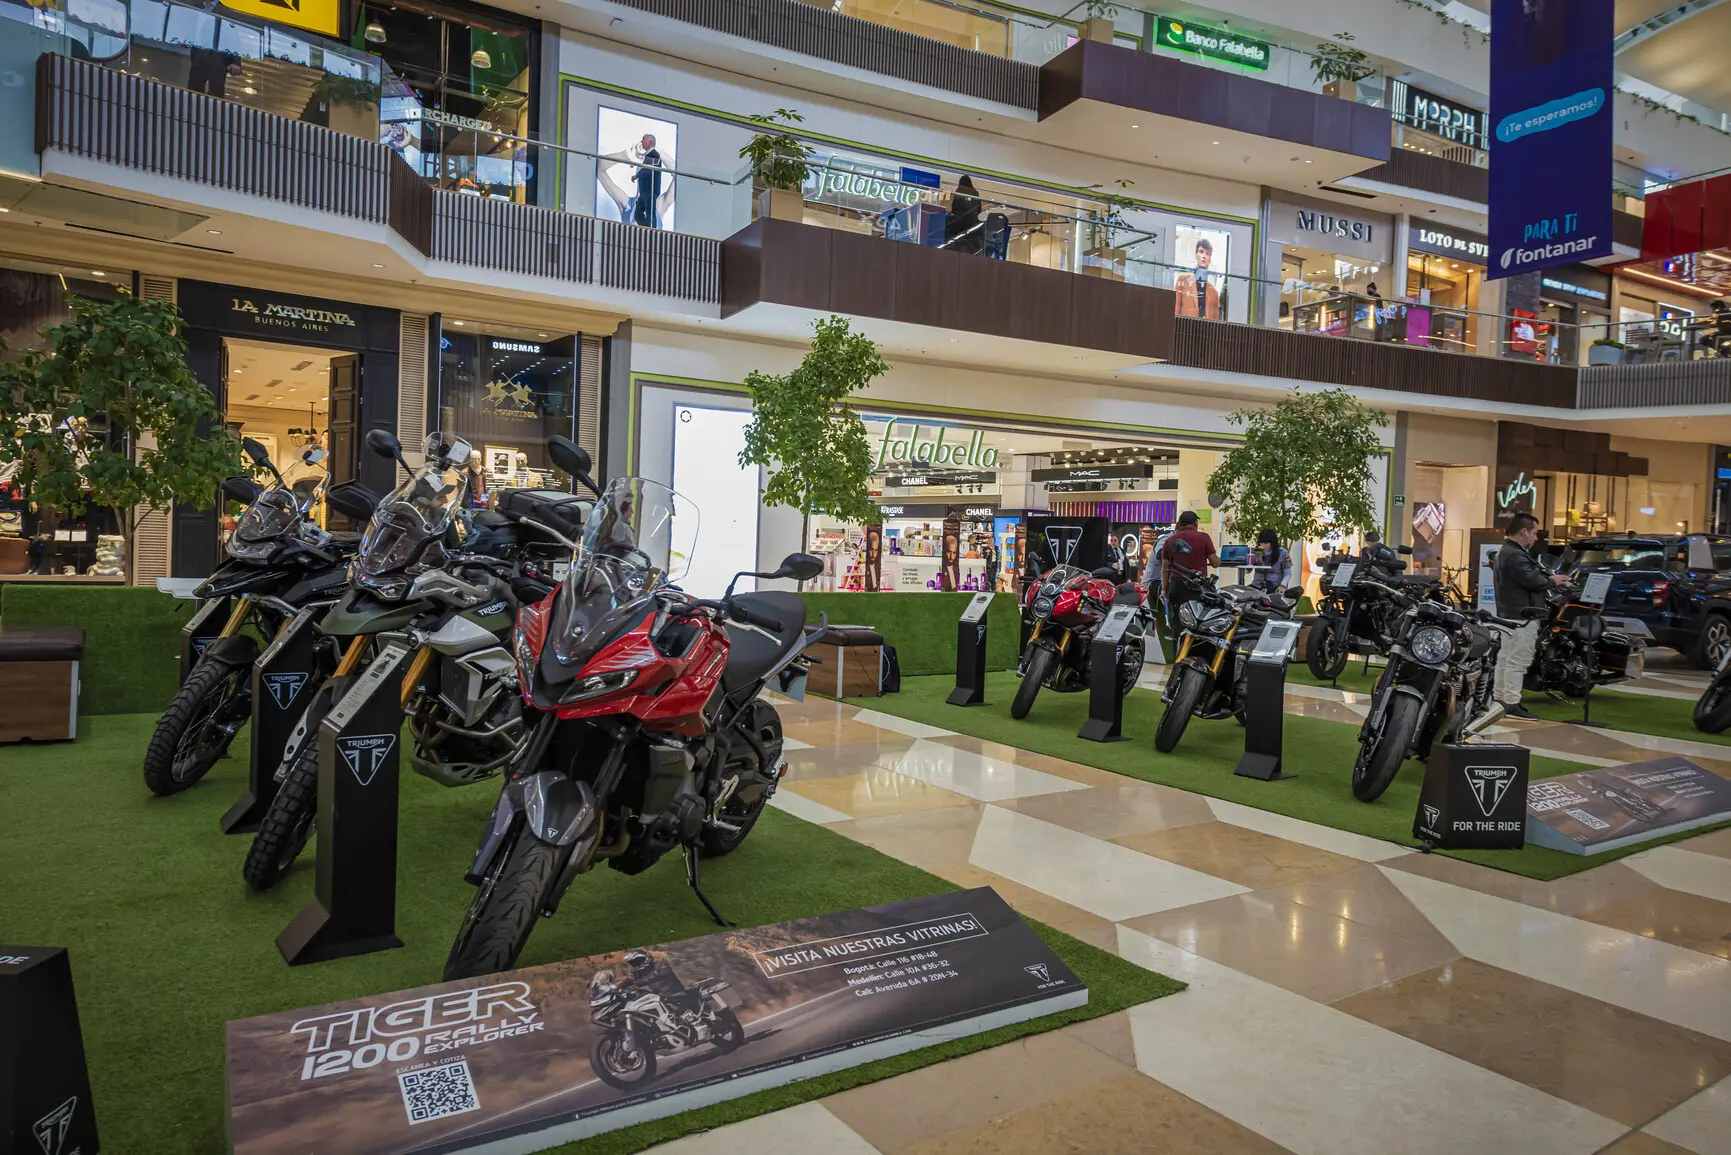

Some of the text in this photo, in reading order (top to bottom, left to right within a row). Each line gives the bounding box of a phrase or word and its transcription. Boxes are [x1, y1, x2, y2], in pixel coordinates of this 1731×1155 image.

[1185, 29, 1265, 61] Banco Falabella
[1413, 95, 1475, 146] MORPH
[1524, 97, 1597, 128] esperamos!
[815, 153, 921, 206] falabella
[1297, 210, 1373, 242] MUSSI
[1523, 217, 1559, 242] PARA
[1419, 229, 1452, 248] LOTO
[1515, 236, 1597, 265] fontanar
[231, 298, 356, 327] LA MARTINA
[254, 316, 329, 332] BUENOS AIRES
[901, 477, 928, 486] CHANEL
[1069, 469, 1100, 477] MAC
[965, 507, 993, 516] CHANEL
[478, 602, 508, 617] TRIUMPH
[347, 738, 384, 748] TRIUMPH
[1474, 769, 1507, 777] TRIUMPH
[1453, 821, 1521, 831] FOR THE RIDE
[764, 919, 979, 973] ¡VISITA NUESTRAS VITRINAS!
[876, 959, 897, 968] Calle
[885, 969, 906, 978] Calle
[905, 965, 921, 974] 10A
[875, 982, 909, 993] Avenida
[909, 978, 922, 986] 6A
[290, 981, 536, 1053] TIGER
[300, 1012, 539, 1081] 1200 RALLY
[424, 1021, 544, 1055] EXPLORER
[395, 1060, 431, 1074] ESCANEA
[440, 1053, 466, 1064] COTIZA
